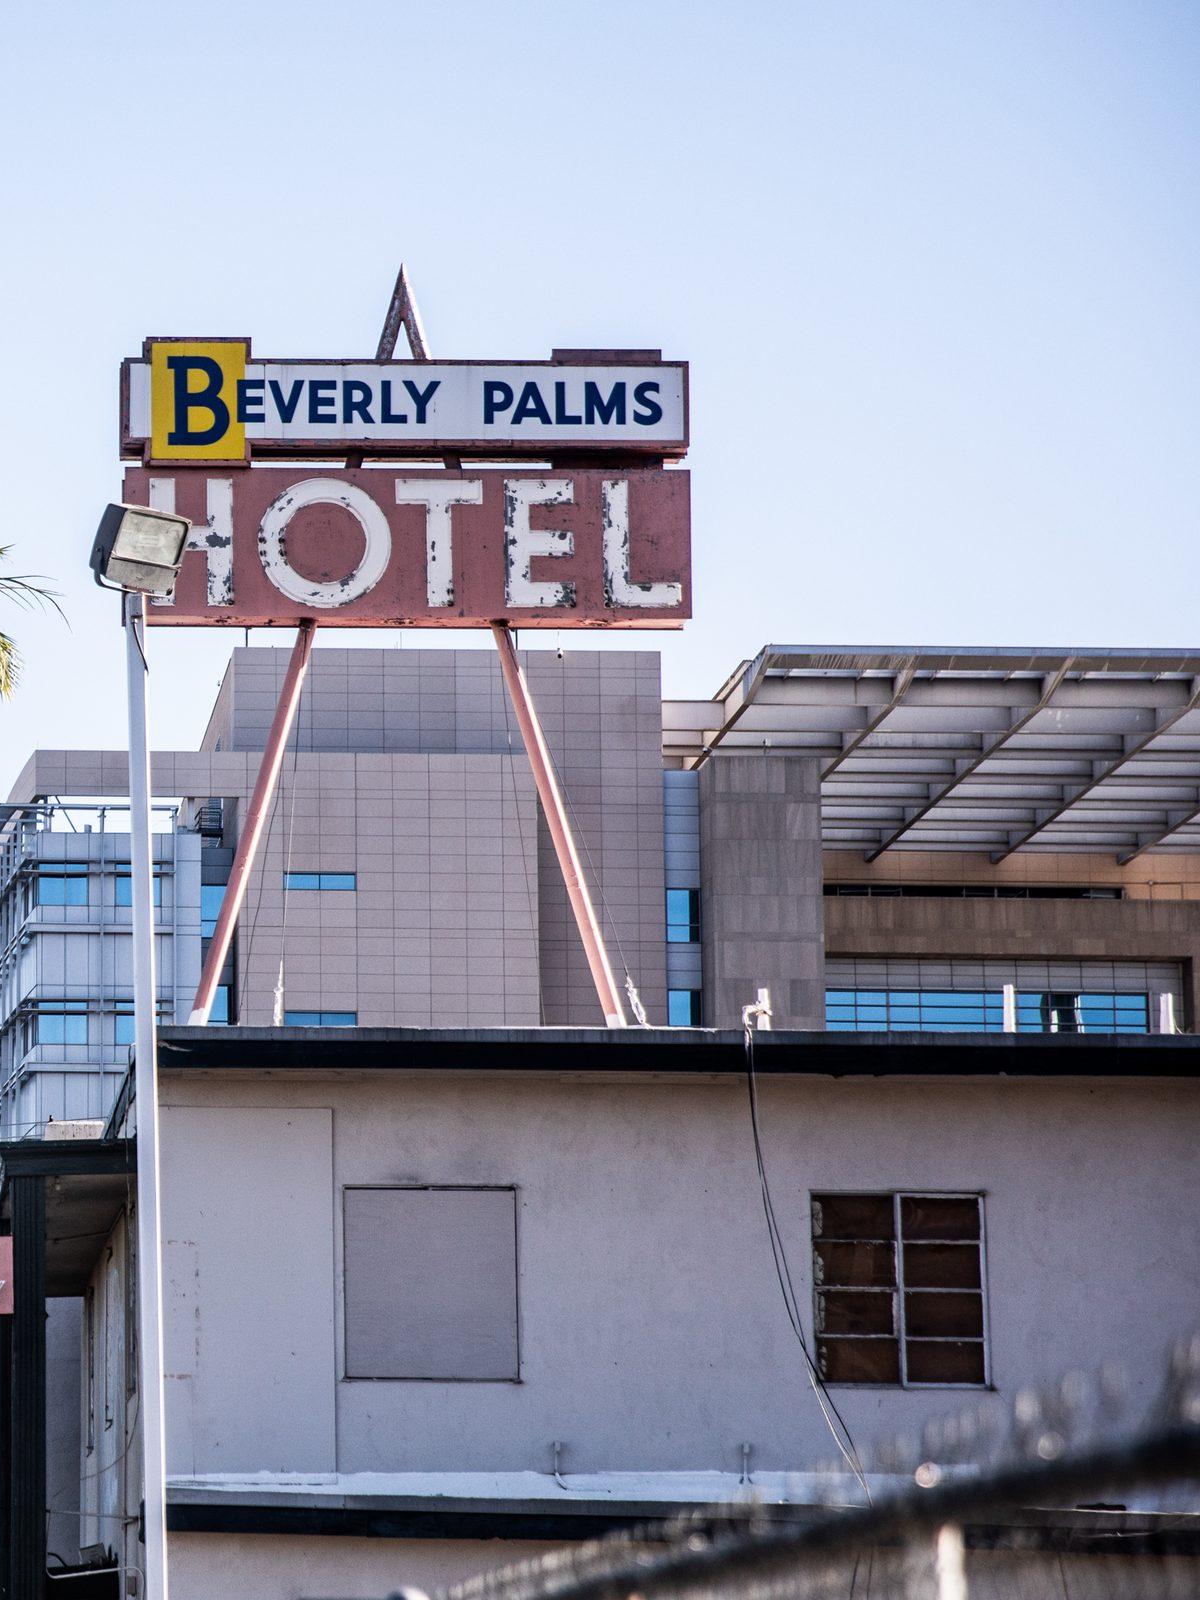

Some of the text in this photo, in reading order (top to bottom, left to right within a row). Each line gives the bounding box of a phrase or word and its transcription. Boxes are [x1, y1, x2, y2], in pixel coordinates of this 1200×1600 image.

[167, 356, 663, 445] BEVERLY PALMS
[149, 477, 681, 608] HOTEL
